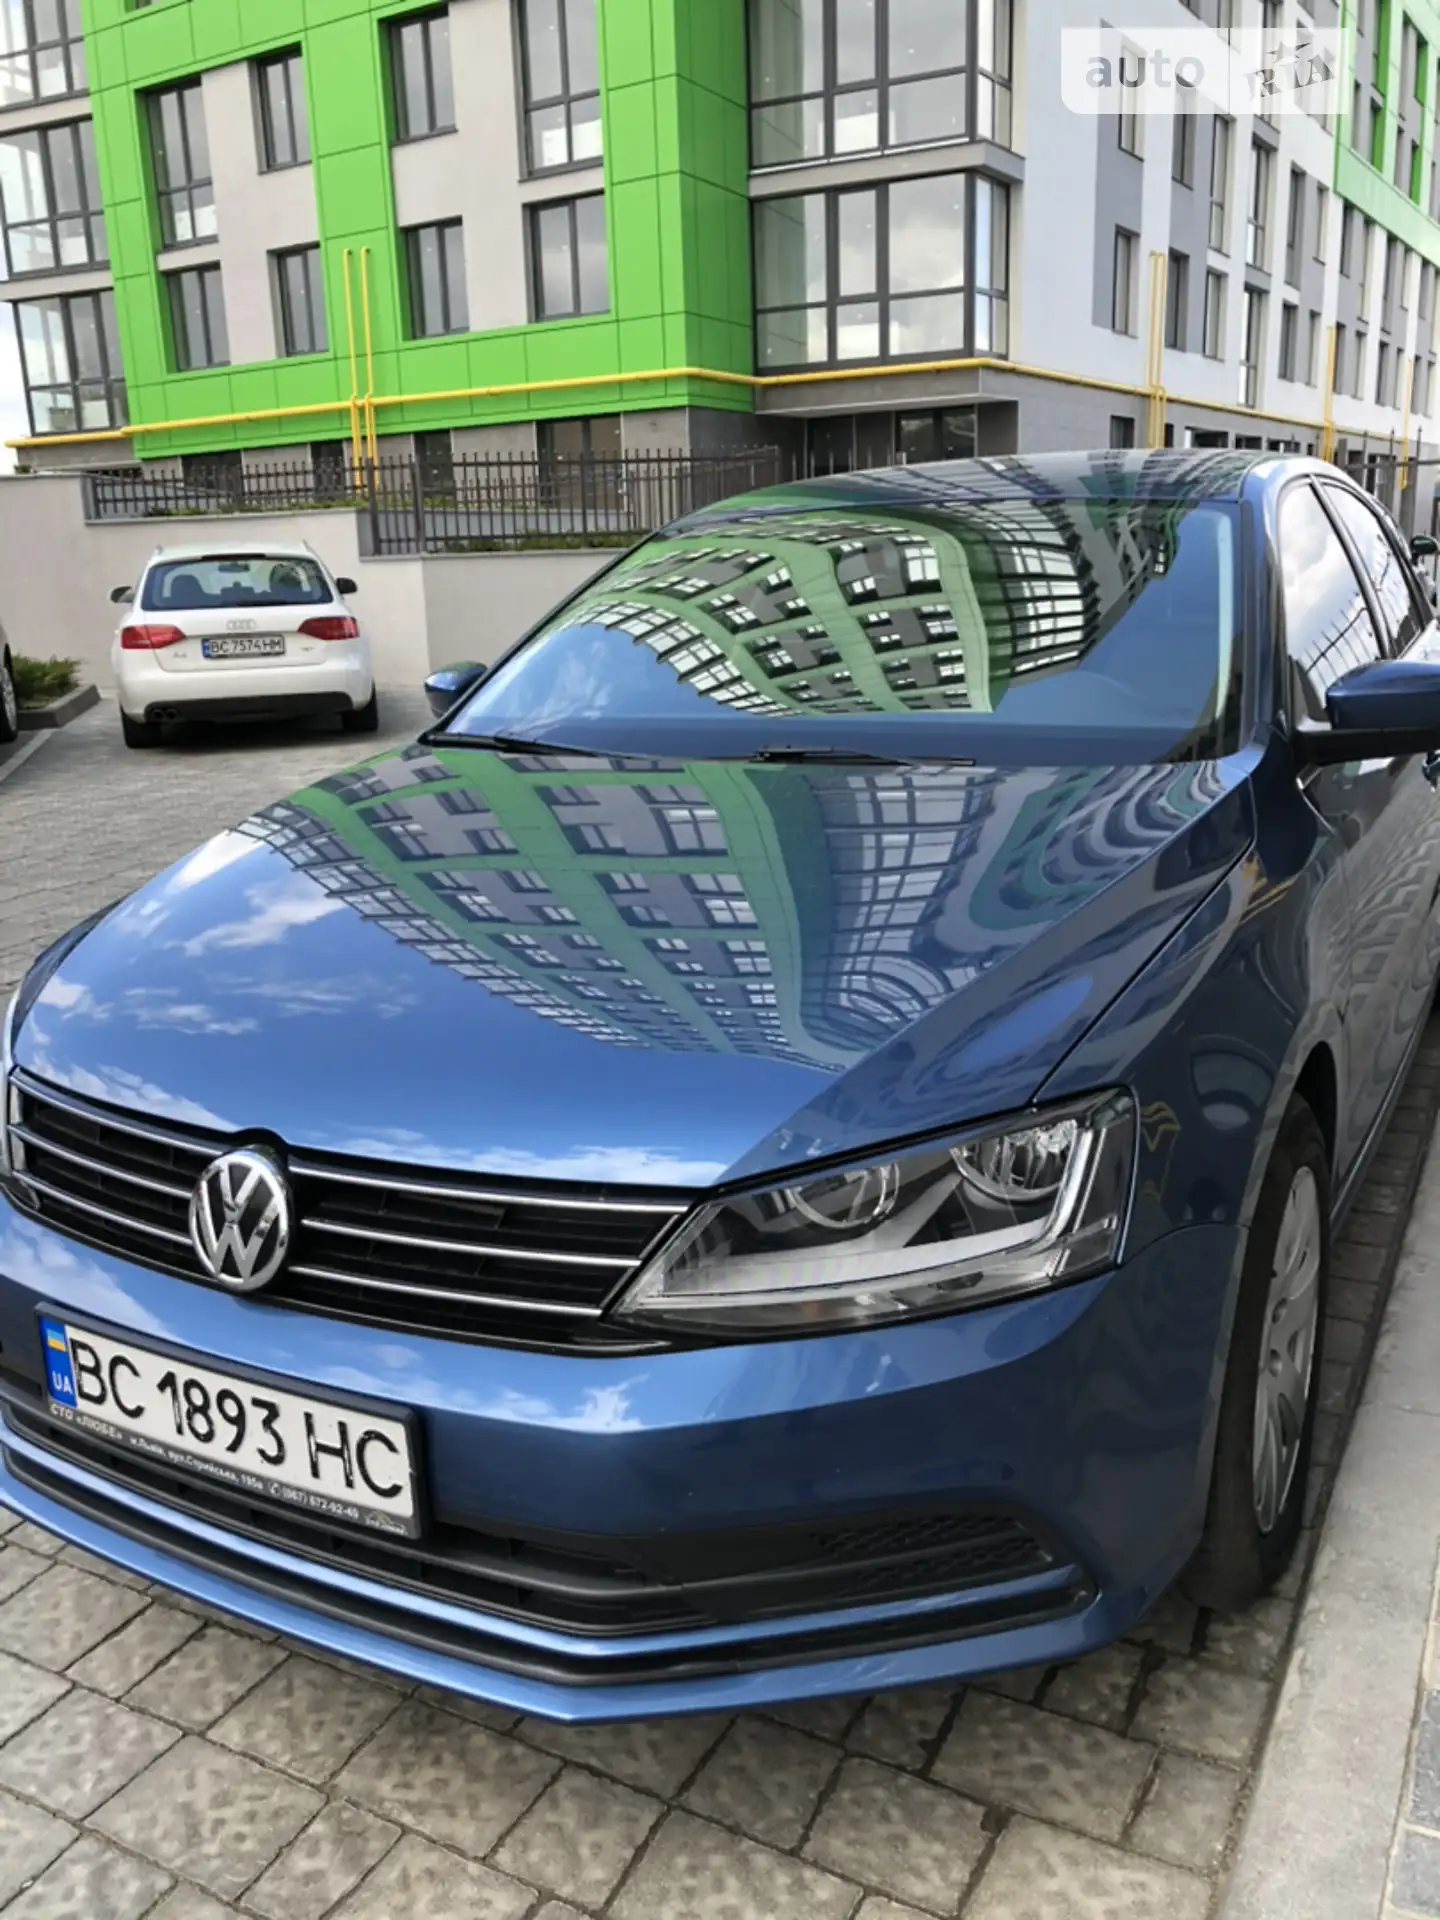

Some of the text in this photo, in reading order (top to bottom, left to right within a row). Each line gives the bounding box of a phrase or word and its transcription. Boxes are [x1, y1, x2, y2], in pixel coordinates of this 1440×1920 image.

[52, 1370, 74, 1395] UA
[70, 1338, 403, 1498] BC 1893 HC
